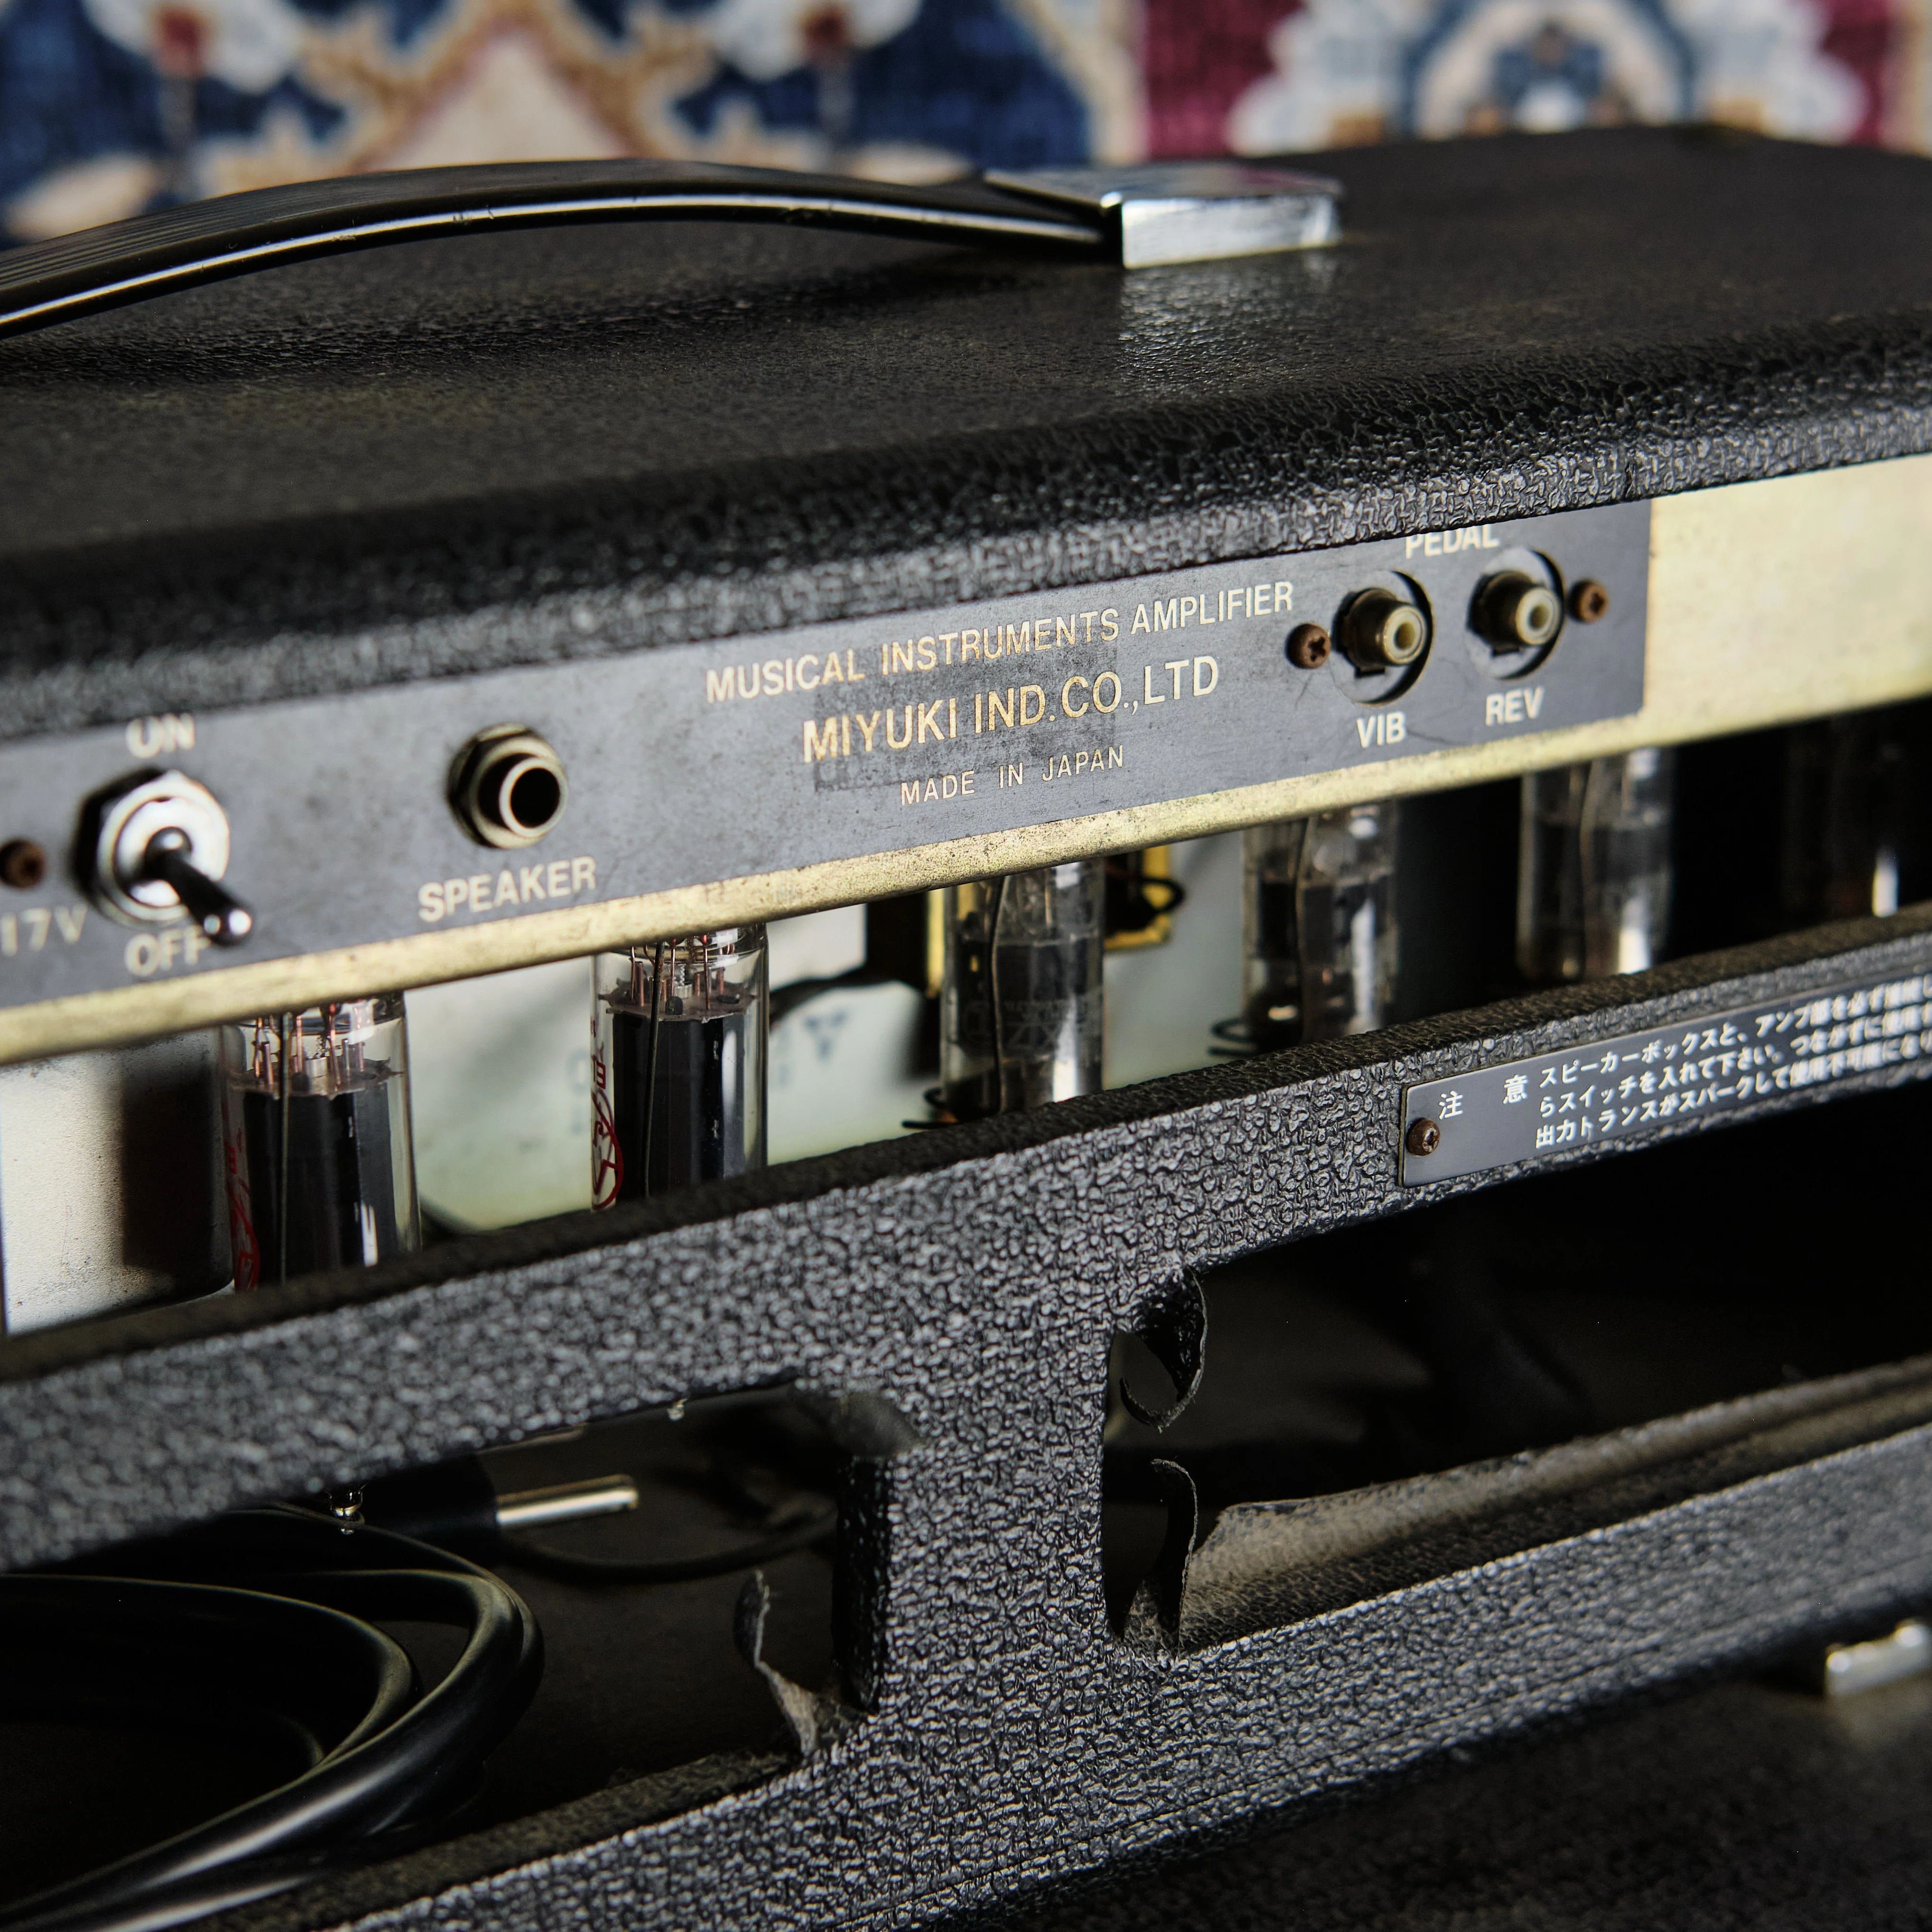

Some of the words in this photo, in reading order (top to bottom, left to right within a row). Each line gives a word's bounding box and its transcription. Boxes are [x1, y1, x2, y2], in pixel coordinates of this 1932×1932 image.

[1406, 523, 1500, 559] PEDAL
[706, 649, 865, 703] MUSICAL
[882, 608, 1119, 675] INSTRUMENTS
[1131, 581, 1294, 635] AMPLIFIER
[803, 697, 958, 763] MIYUKI
[1356, 712, 1407, 749] VIB
[1485, 686, 1545, 726] REV
[125, 713, 196, 759] ON
[900, 770, 975, 807] MADE
[999, 762, 1023, 789] IN
[1041, 744, 1124, 782] JAPAN
[418, 855, 597, 922] SPEAKER
[124, 925, 210, 977] OFF
